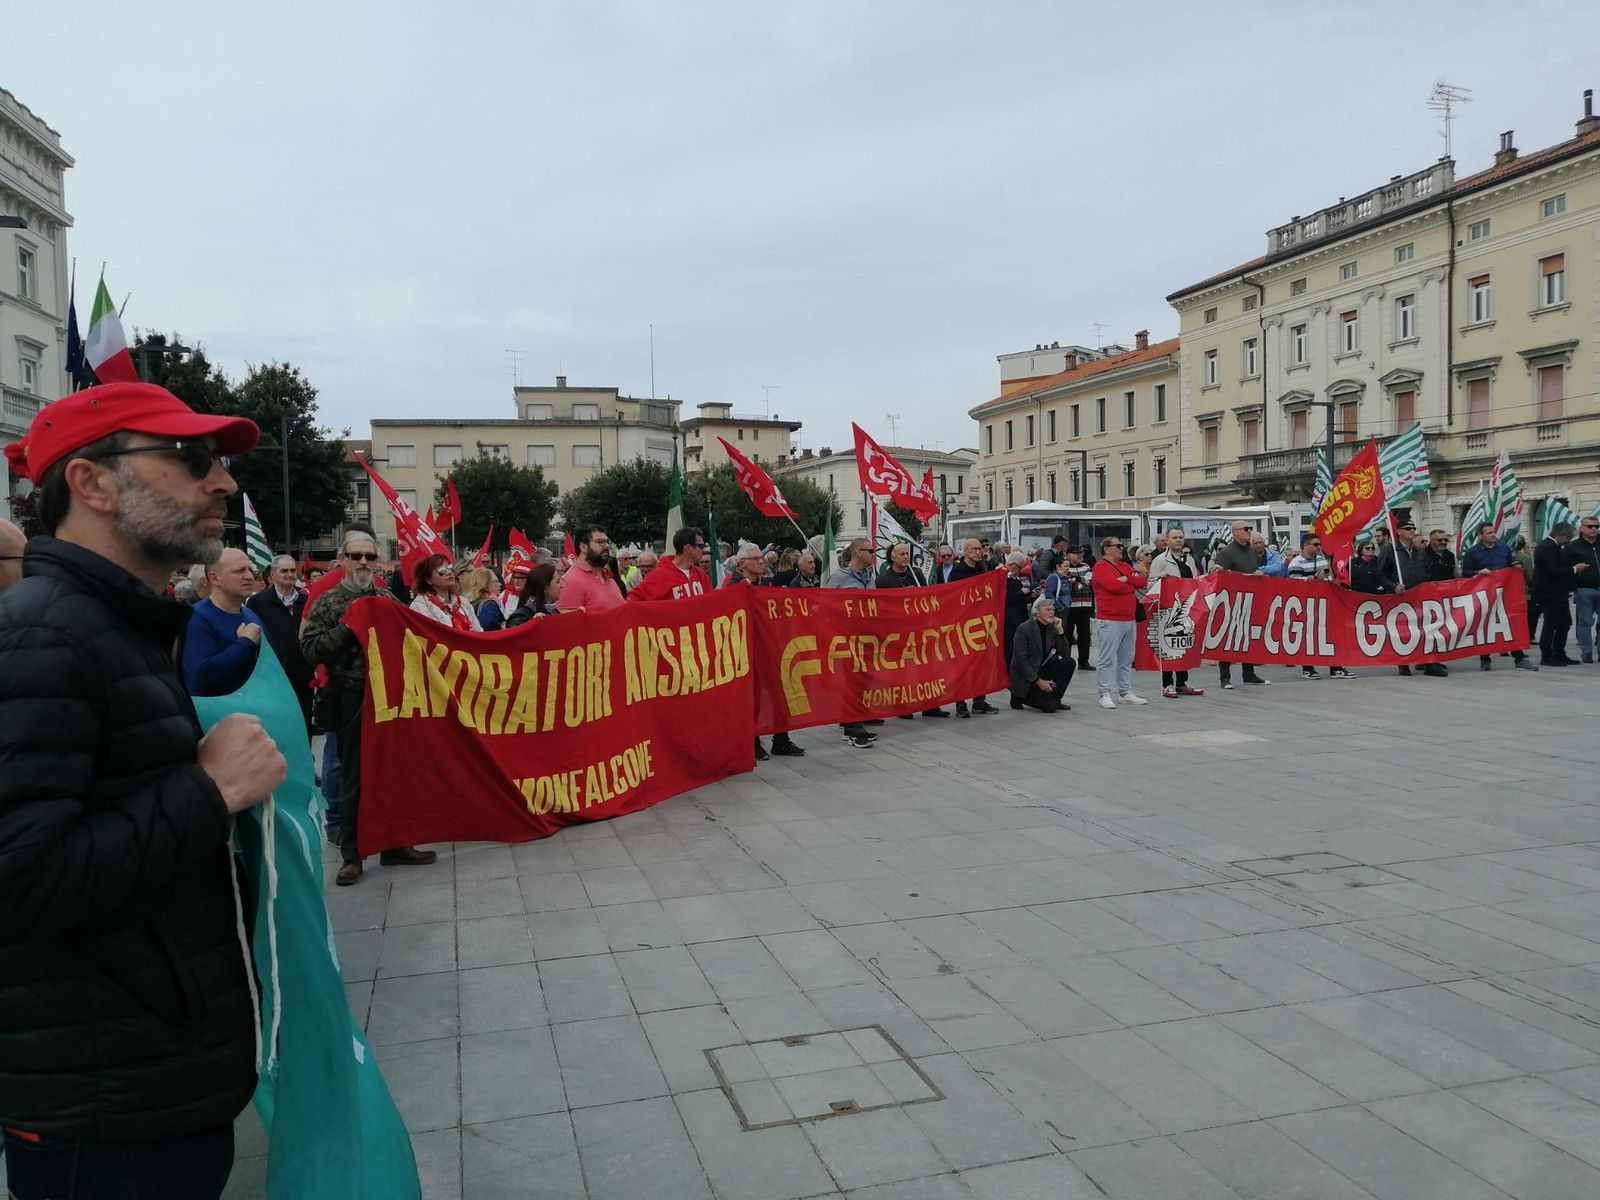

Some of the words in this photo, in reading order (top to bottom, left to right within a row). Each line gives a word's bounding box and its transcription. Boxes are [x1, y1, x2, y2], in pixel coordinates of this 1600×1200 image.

[845, 598, 877, 618] FIM
[1355, 587, 1513, 657] GORIZIA
[368, 626, 612, 735] LAVORATORI
[624, 608, 750, 706] ANSALDO
[827, 613, 1000, 674] FINCANTIER
[1171, 636, 1193, 648] FIOM
[862, 678, 947, 707] MONFALCONE
[512, 739, 655, 816] MONFALCONE
